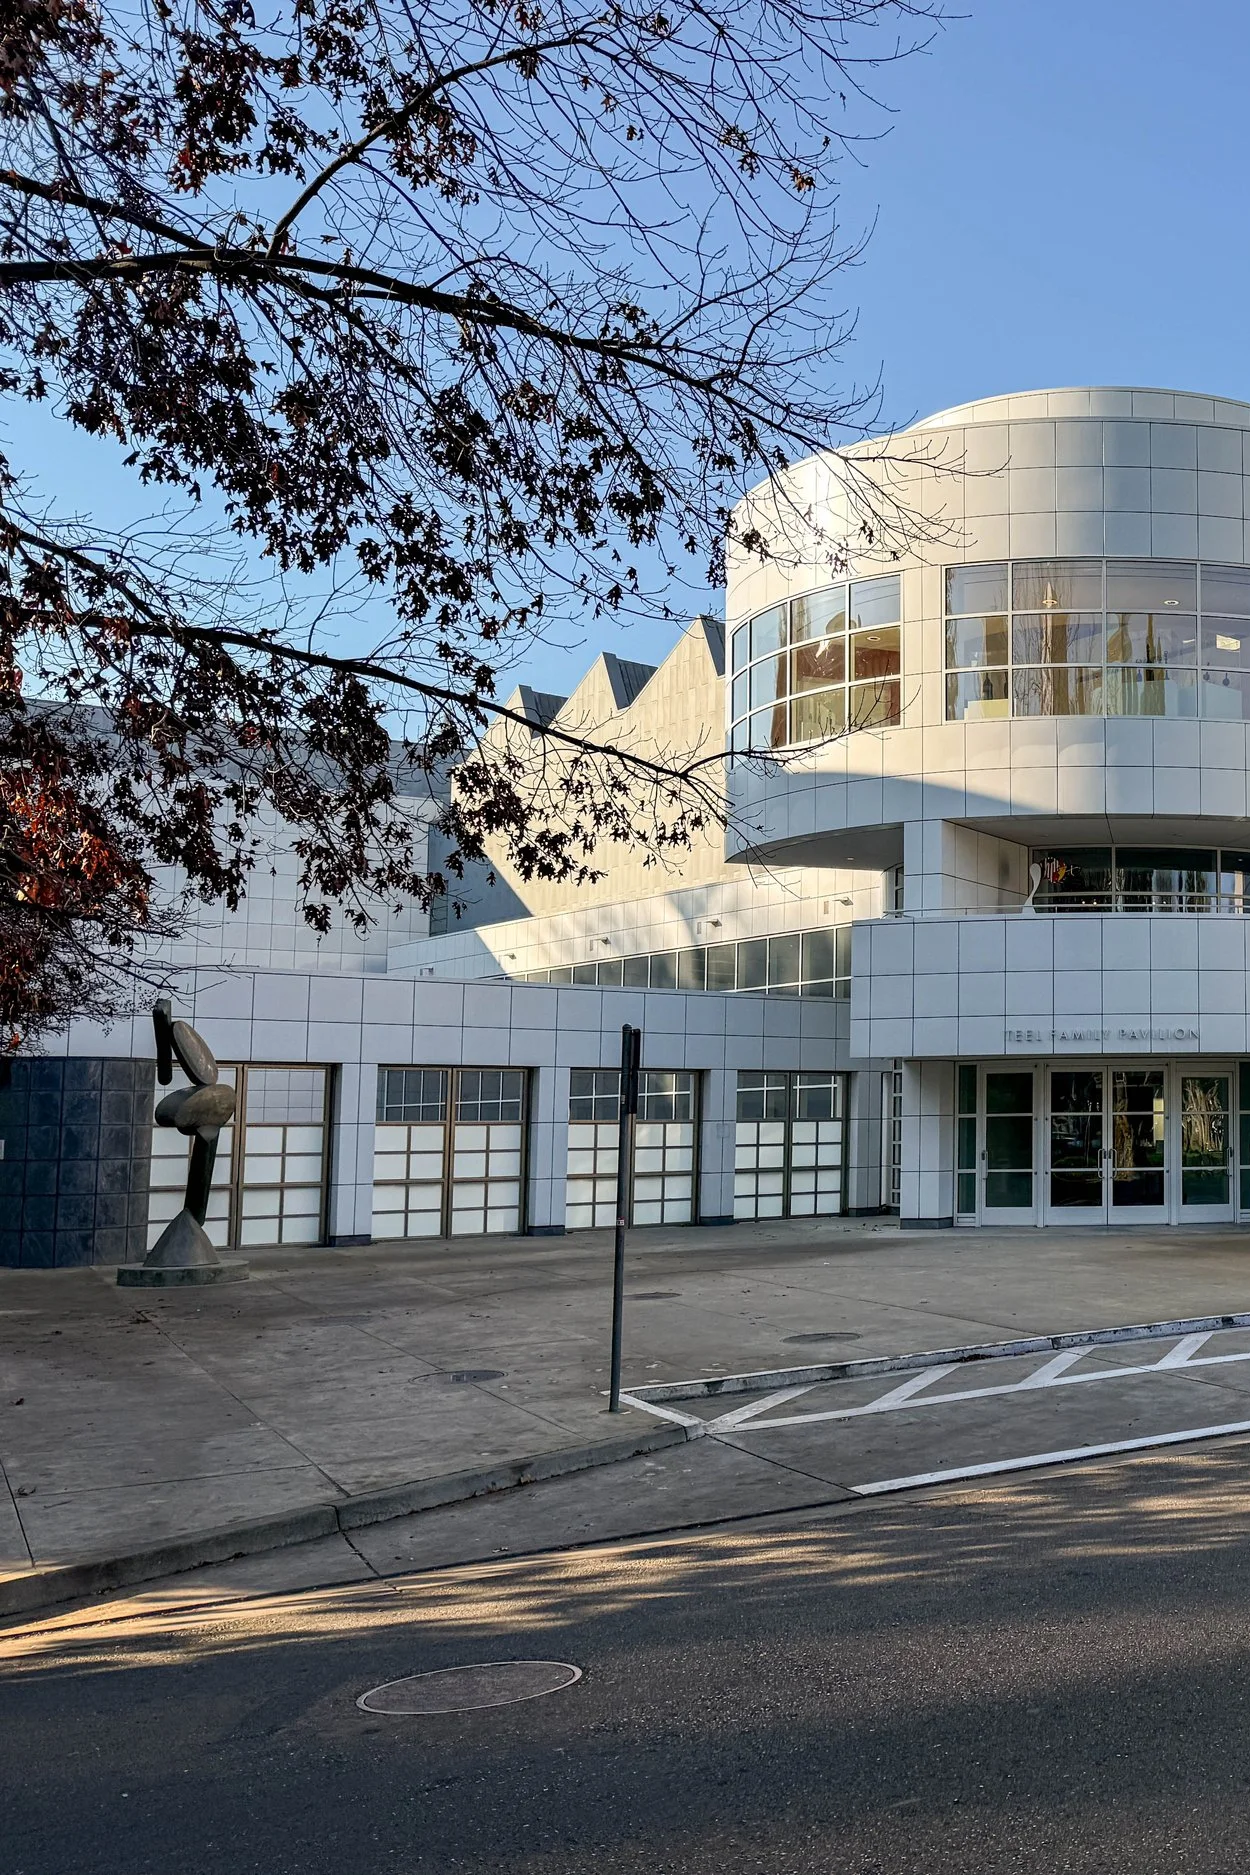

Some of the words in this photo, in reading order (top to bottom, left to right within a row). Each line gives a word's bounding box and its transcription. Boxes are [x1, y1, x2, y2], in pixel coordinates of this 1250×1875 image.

[1005, 1030, 1042, 1042] TEEL
[1049, 1029, 1110, 1041] FAMILY
[1118, 1028, 1200, 1041] PAVILION
